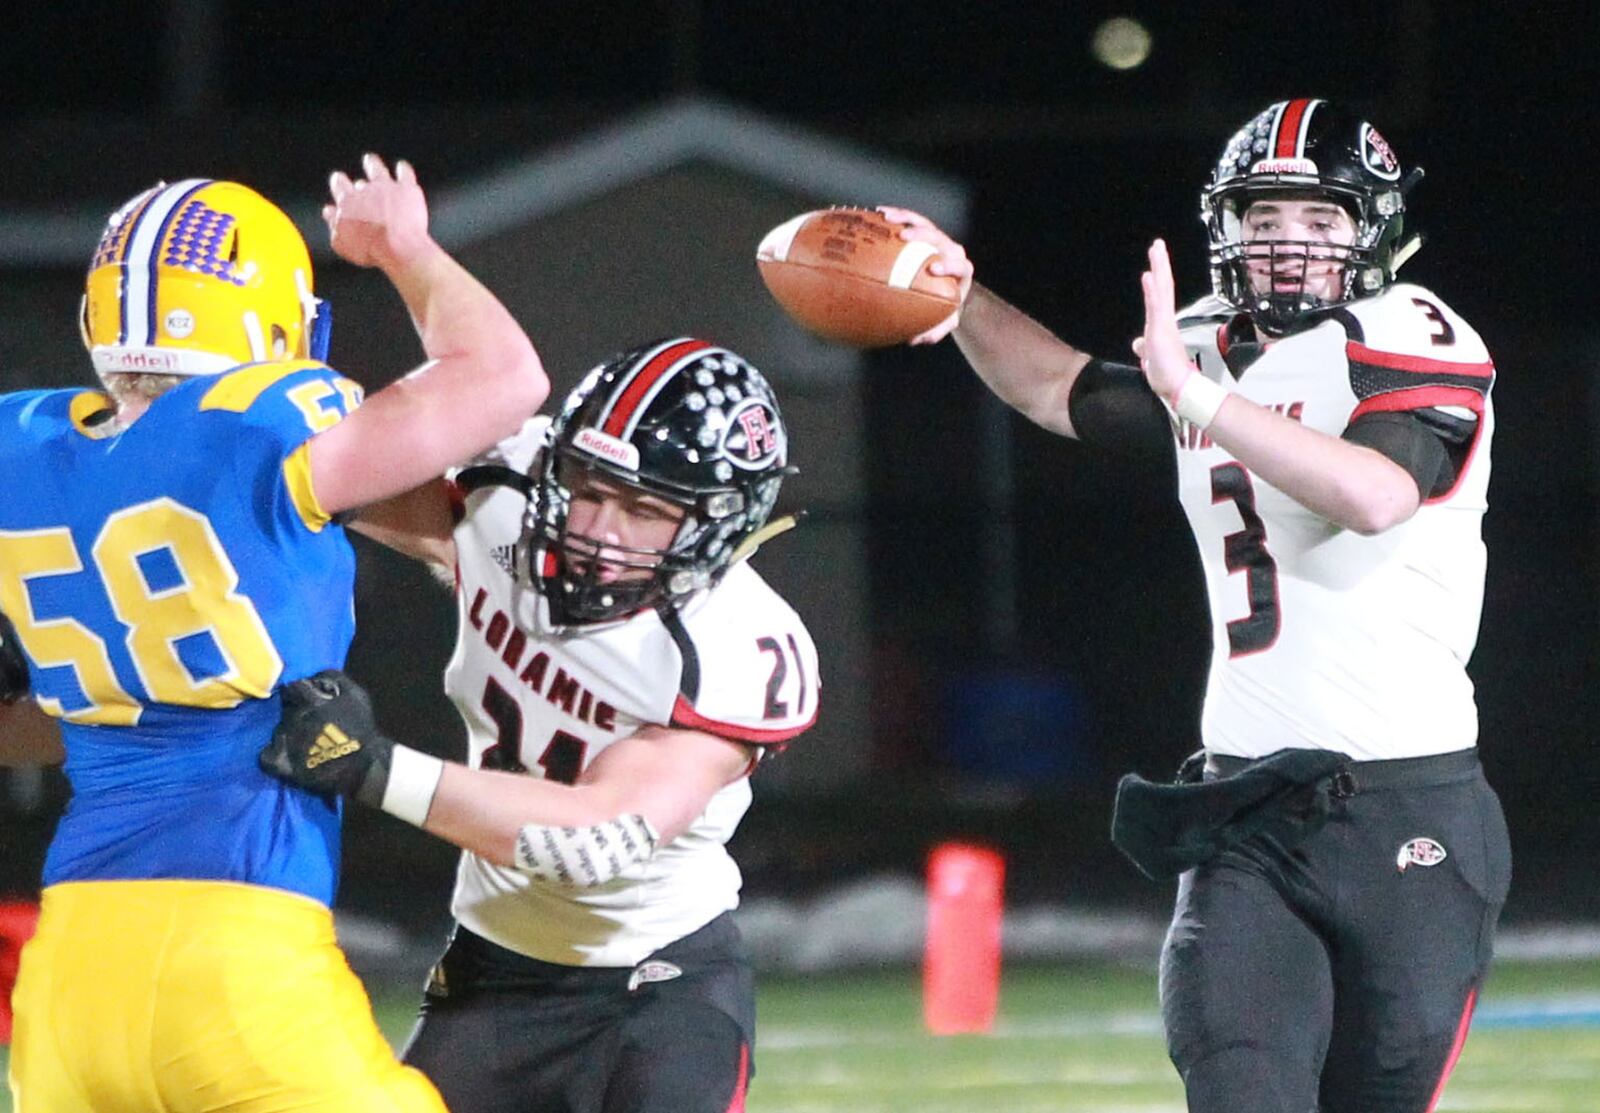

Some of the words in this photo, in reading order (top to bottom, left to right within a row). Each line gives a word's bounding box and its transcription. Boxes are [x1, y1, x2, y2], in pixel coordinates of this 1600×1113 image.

[1411, 297, 1456, 346] 3
[103, 351, 178, 368] ddell
[579, 431, 630, 461] Riddell
[1210, 461, 1282, 660] 3
[0, 496, 285, 726] 58
[469, 586, 618, 733] LORAMIE
[754, 633, 806, 720] 21
[306, 738, 362, 769] adidas
